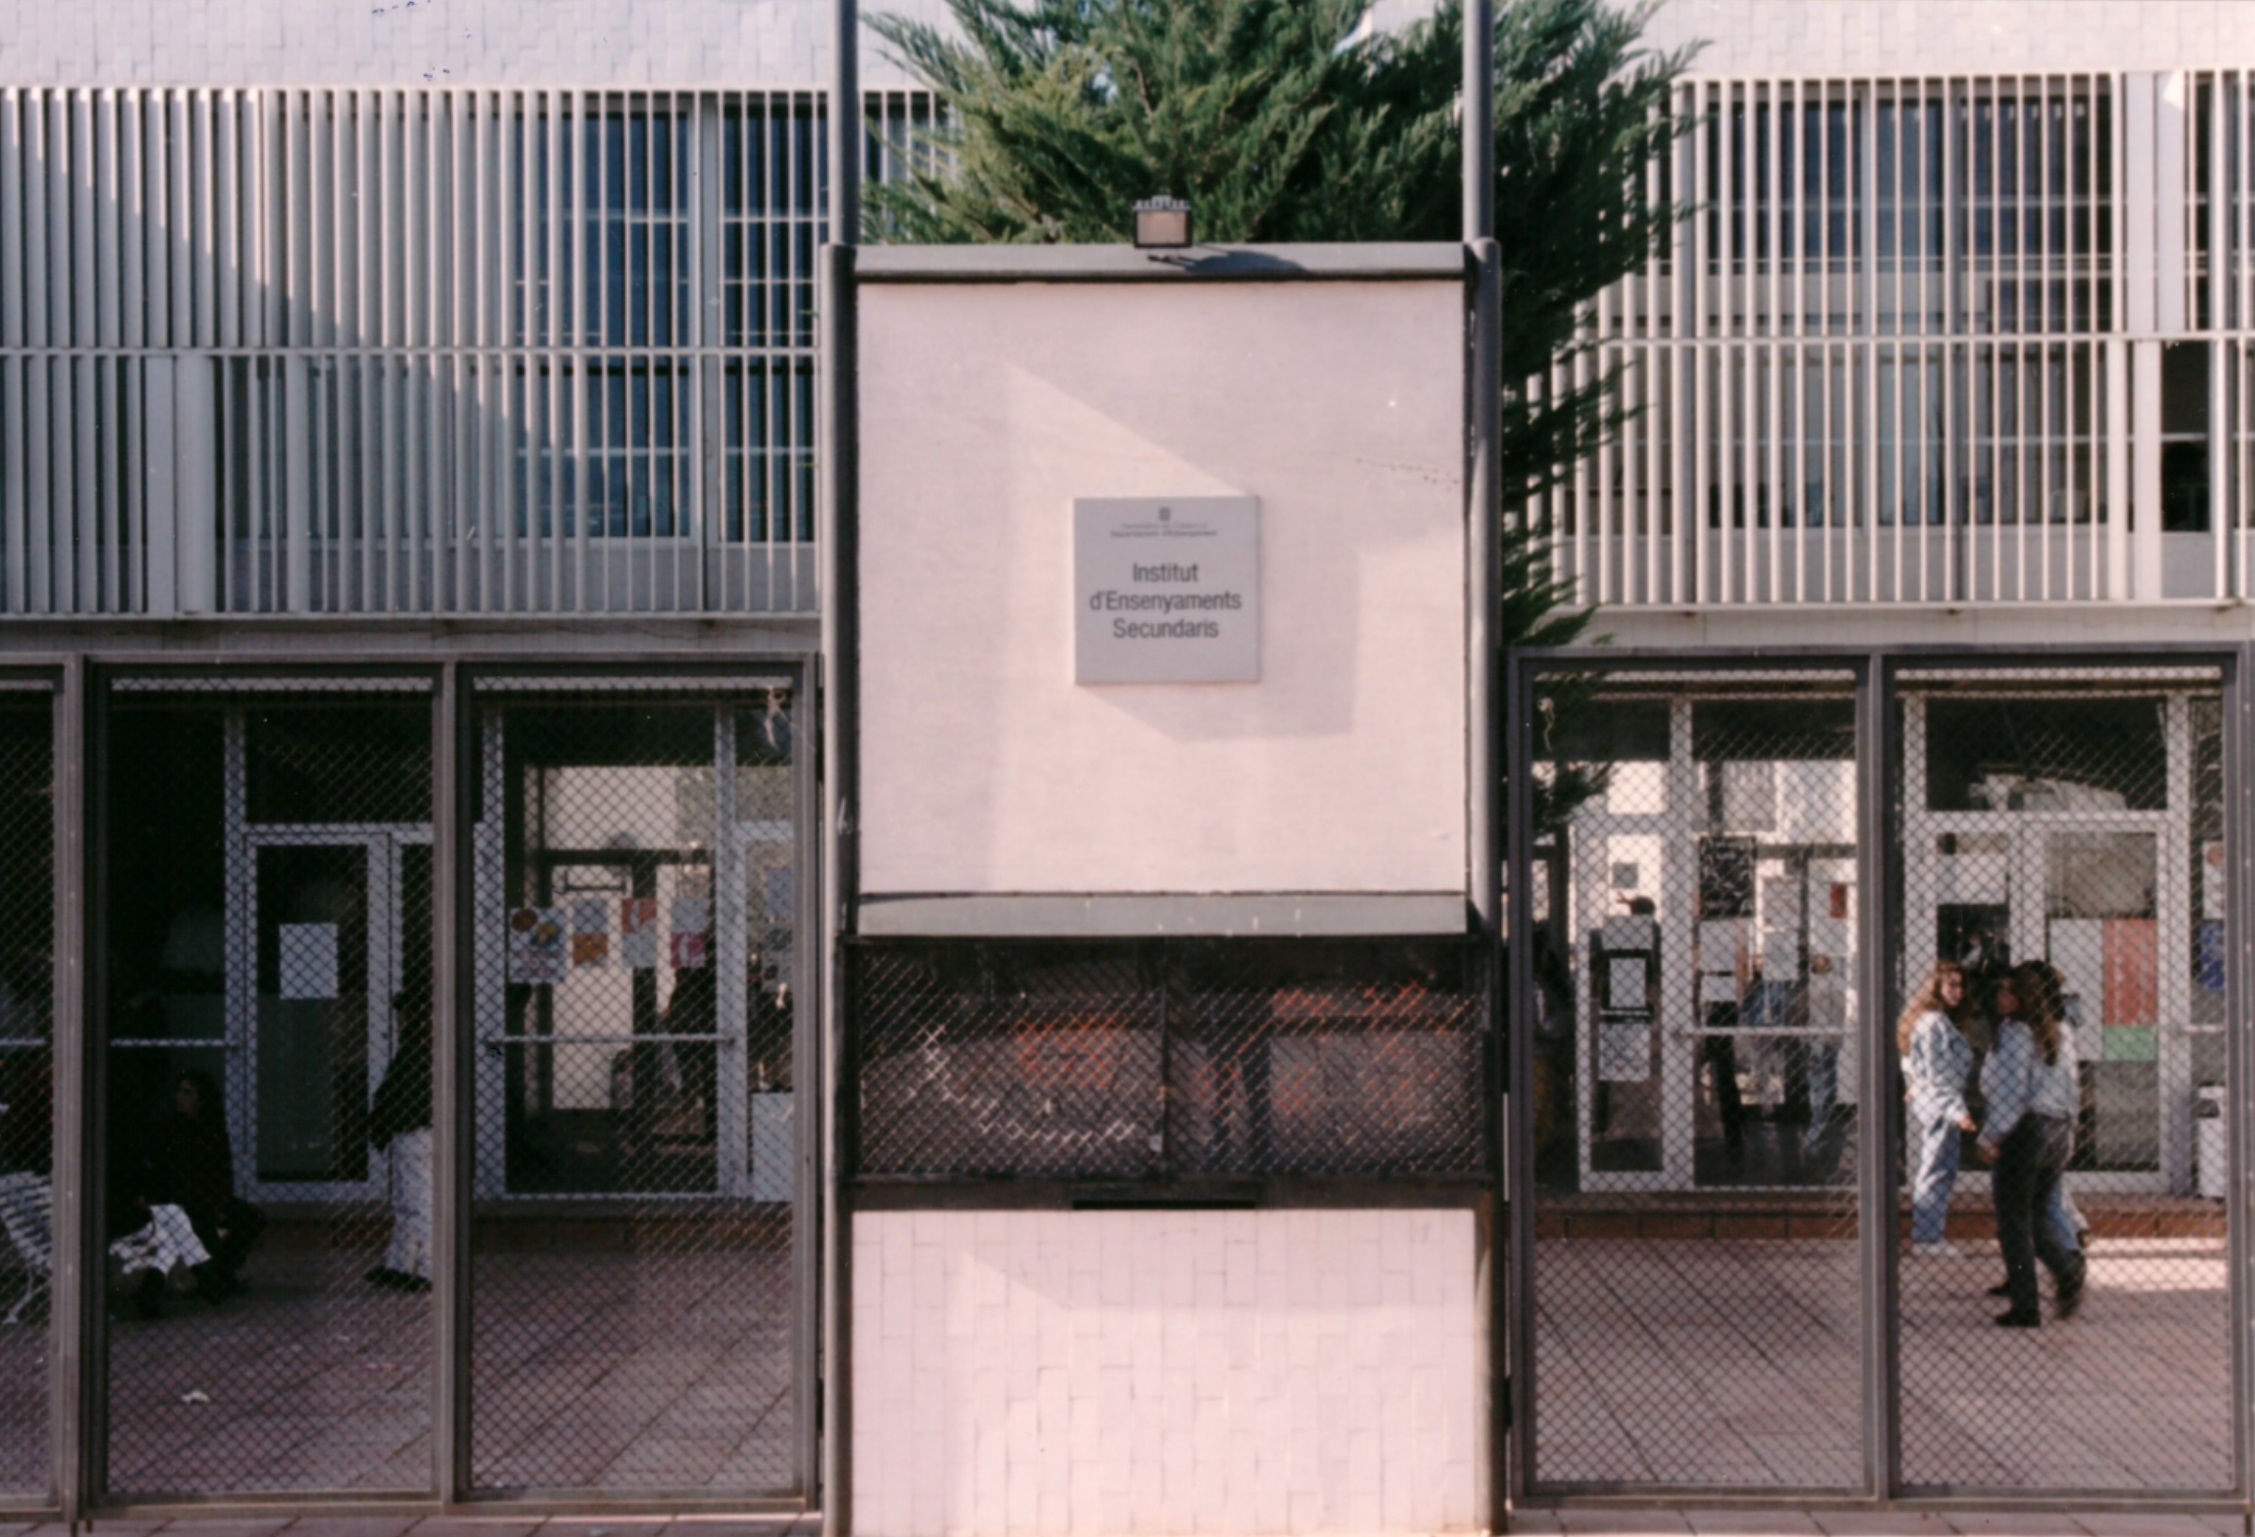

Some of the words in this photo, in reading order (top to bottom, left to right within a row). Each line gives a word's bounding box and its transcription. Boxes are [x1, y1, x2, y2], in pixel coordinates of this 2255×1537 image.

[1132, 562, 1199, 582] Institut
[1089, 590, 1242, 613] d'Ensenyaments
[1112, 617, 1219, 638] Secundaris
